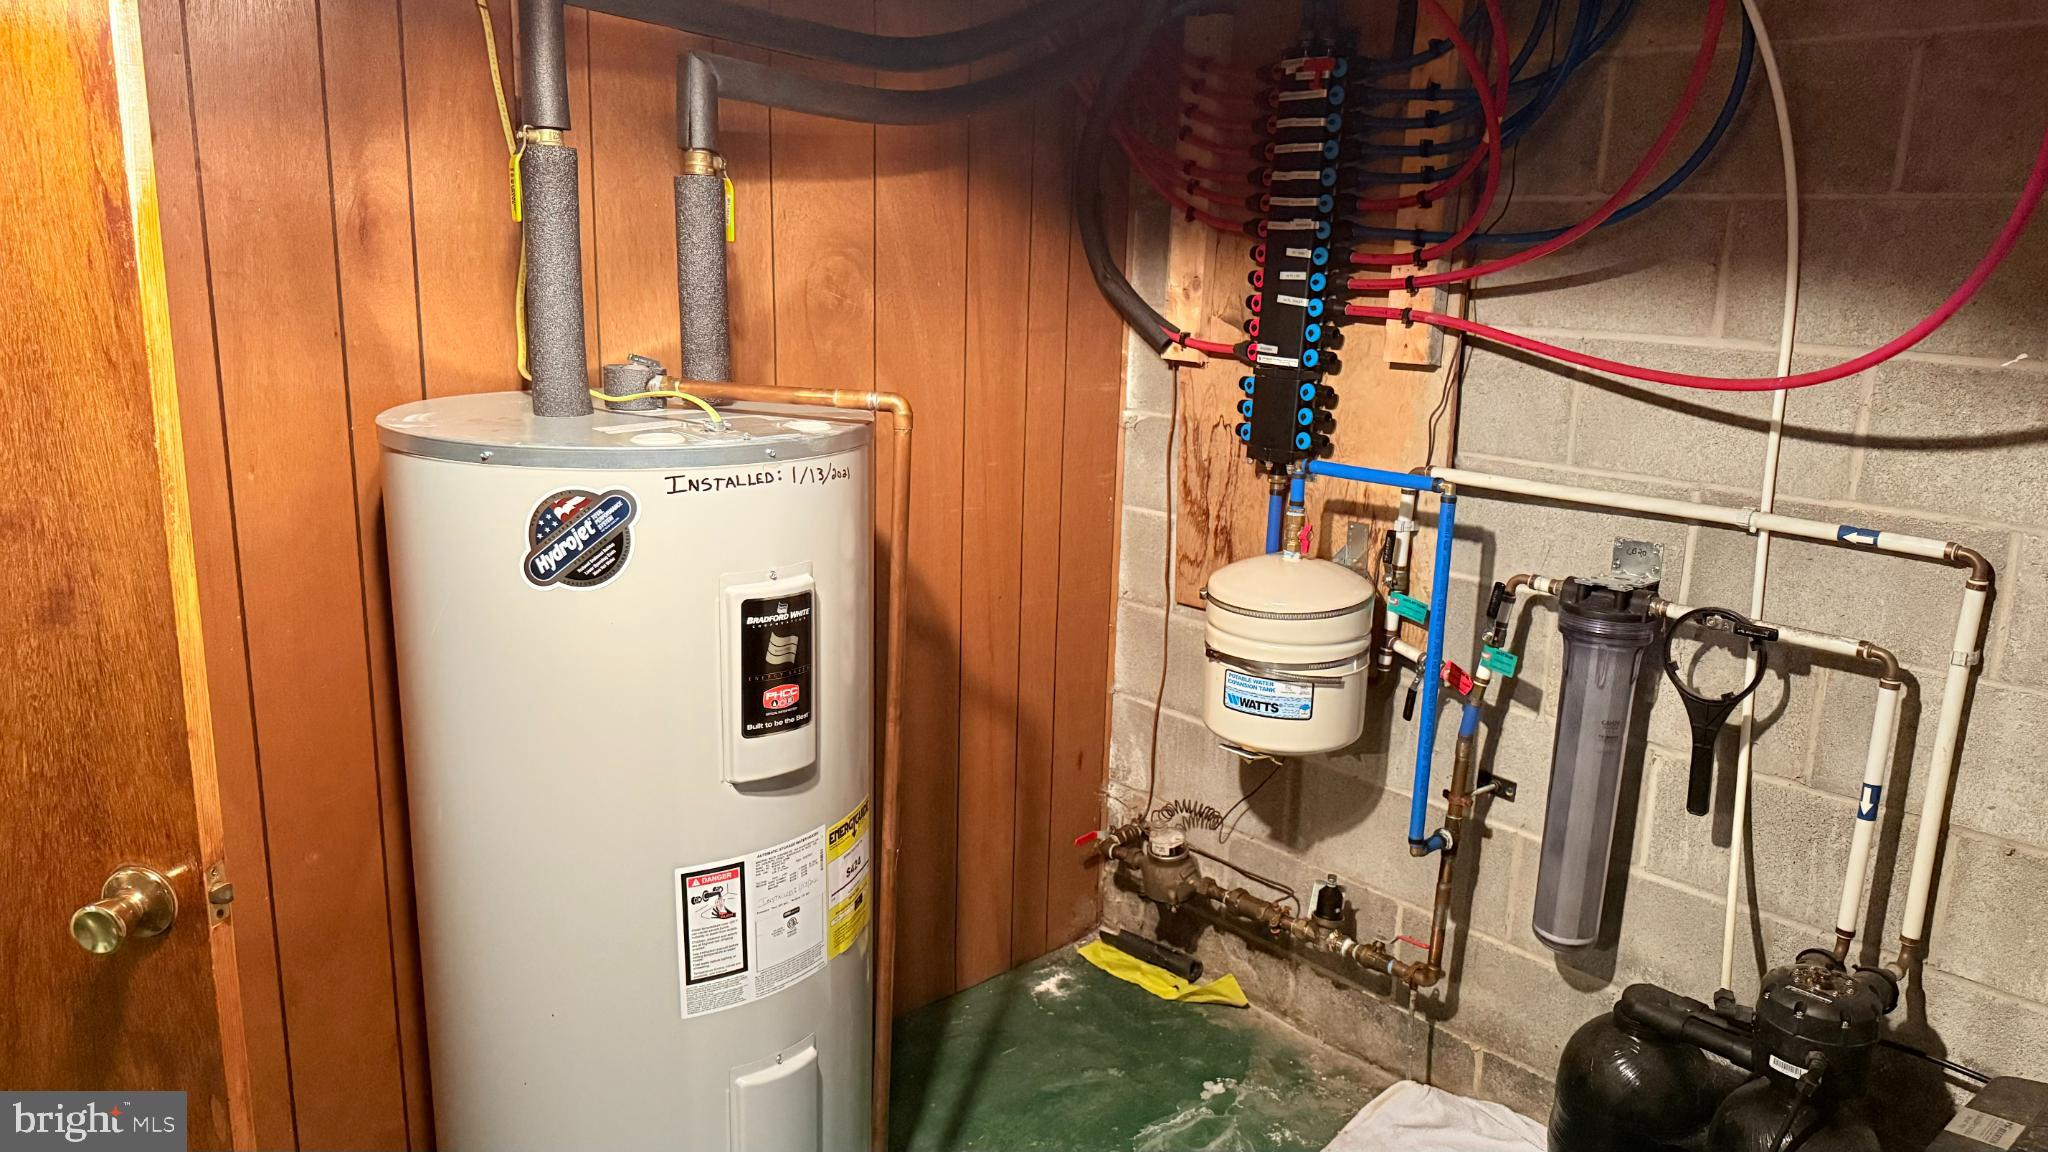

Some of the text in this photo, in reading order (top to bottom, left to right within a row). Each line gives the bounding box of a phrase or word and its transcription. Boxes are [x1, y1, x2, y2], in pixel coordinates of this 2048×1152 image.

[664, 462, 851, 495] INSTALLED: 1/13/2021
[535, 518, 597, 575] Hydrojet
[746, 607, 811, 625] BRADFORD WHITE
[1253, 676, 1275, 687] WATER
[1259, 685, 1276, 693] TANK
[765, 686, 799, 700] PHCC
[1240, 697, 1280, 713] WATTS
[746, 722, 764, 731] Built
[765, 721, 773, 729] to
[784, 716, 795, 724] the
[701, 871, 733, 885] DANGER
